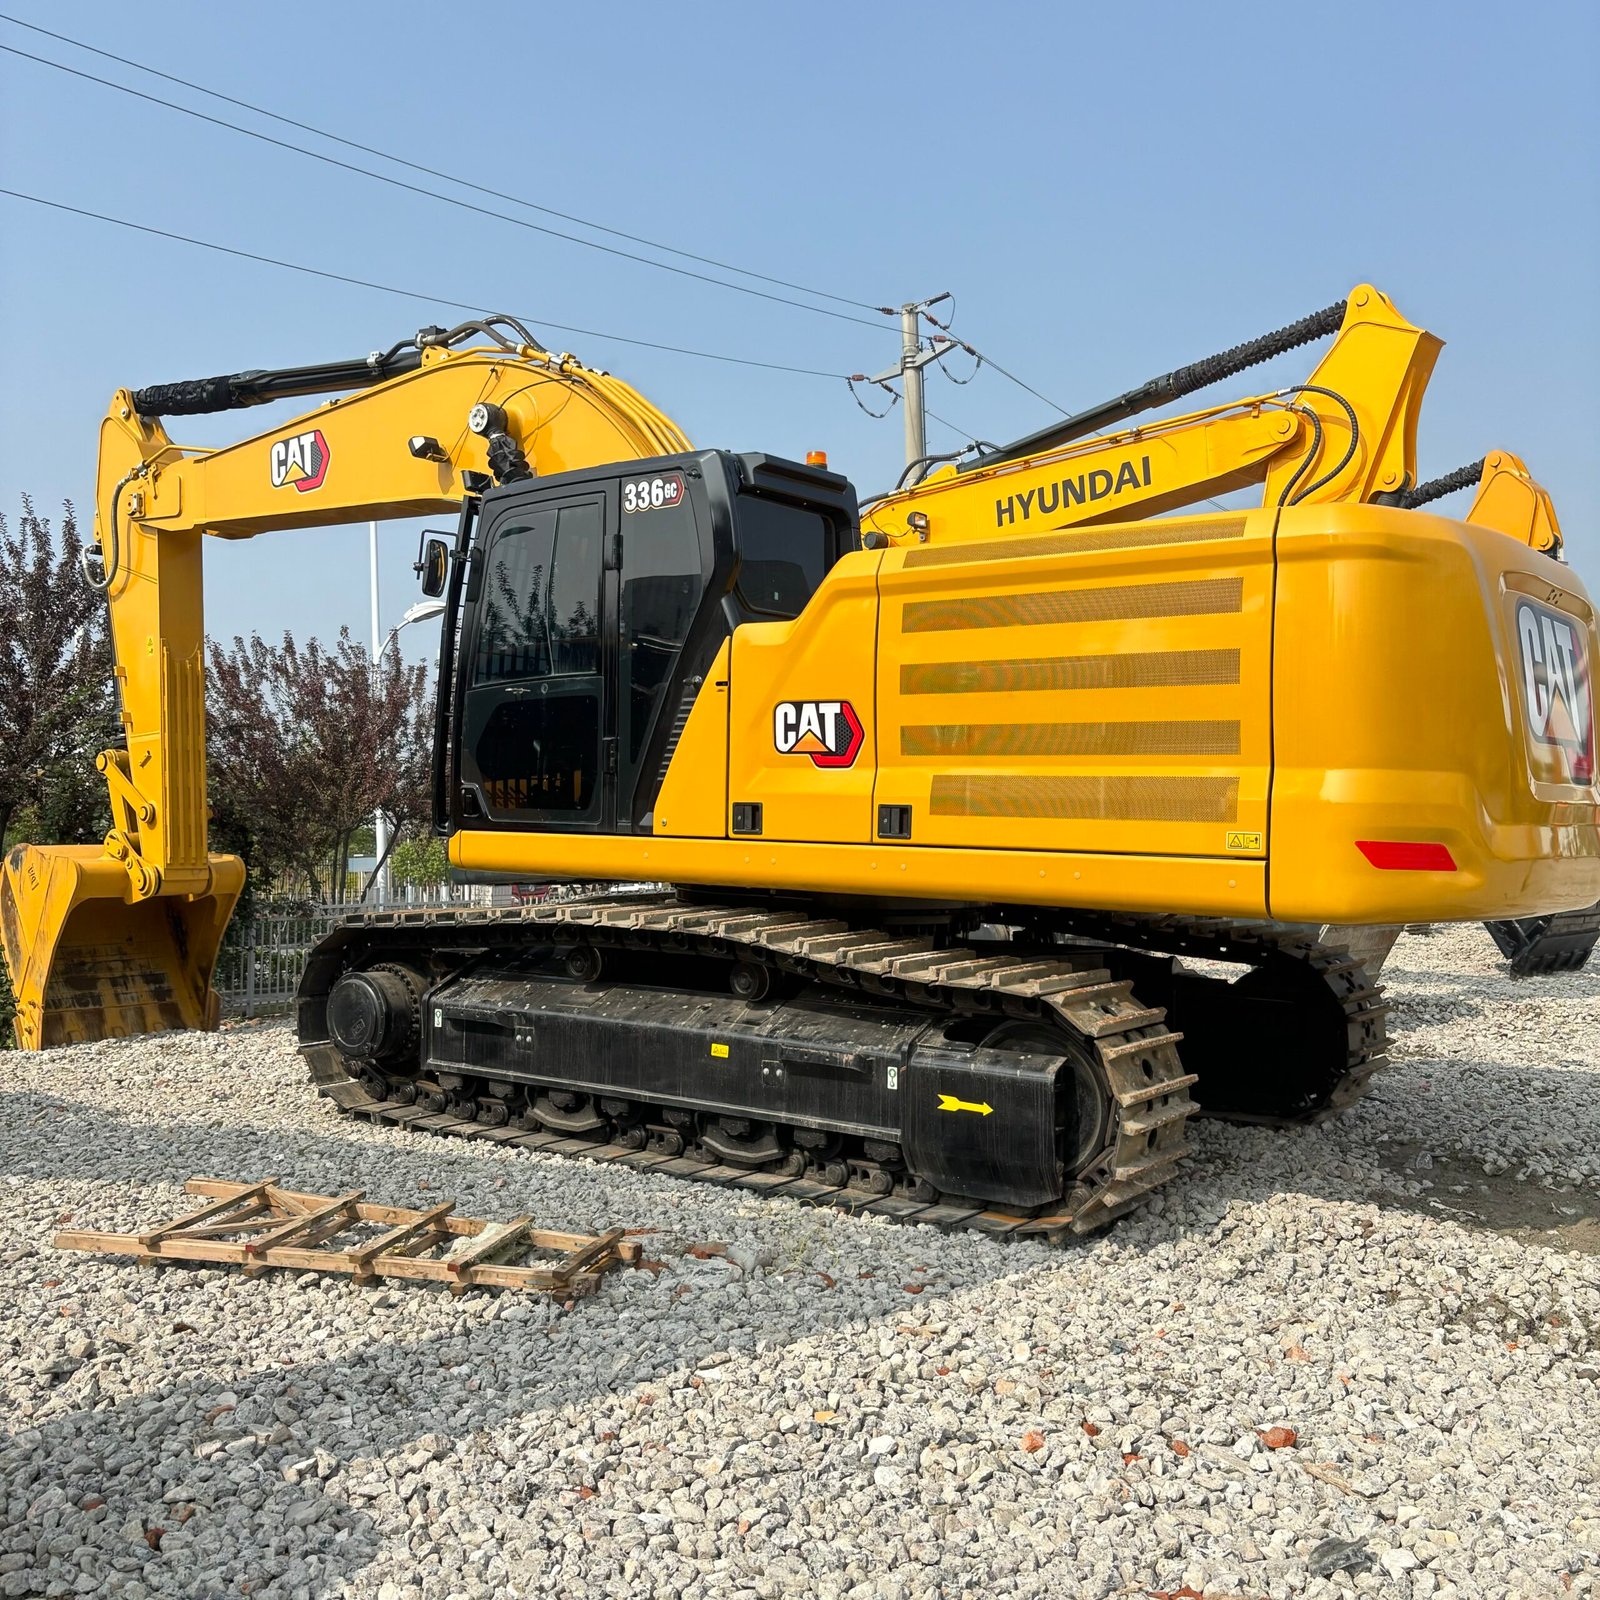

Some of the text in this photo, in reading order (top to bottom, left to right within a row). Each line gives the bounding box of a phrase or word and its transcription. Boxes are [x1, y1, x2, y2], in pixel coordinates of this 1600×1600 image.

[271, 431, 316, 486] CAT
[995, 455, 1152, 528] HYUNDAI
[1518, 606, 1583, 743] CAT
[775, 702, 841, 753] CAT
